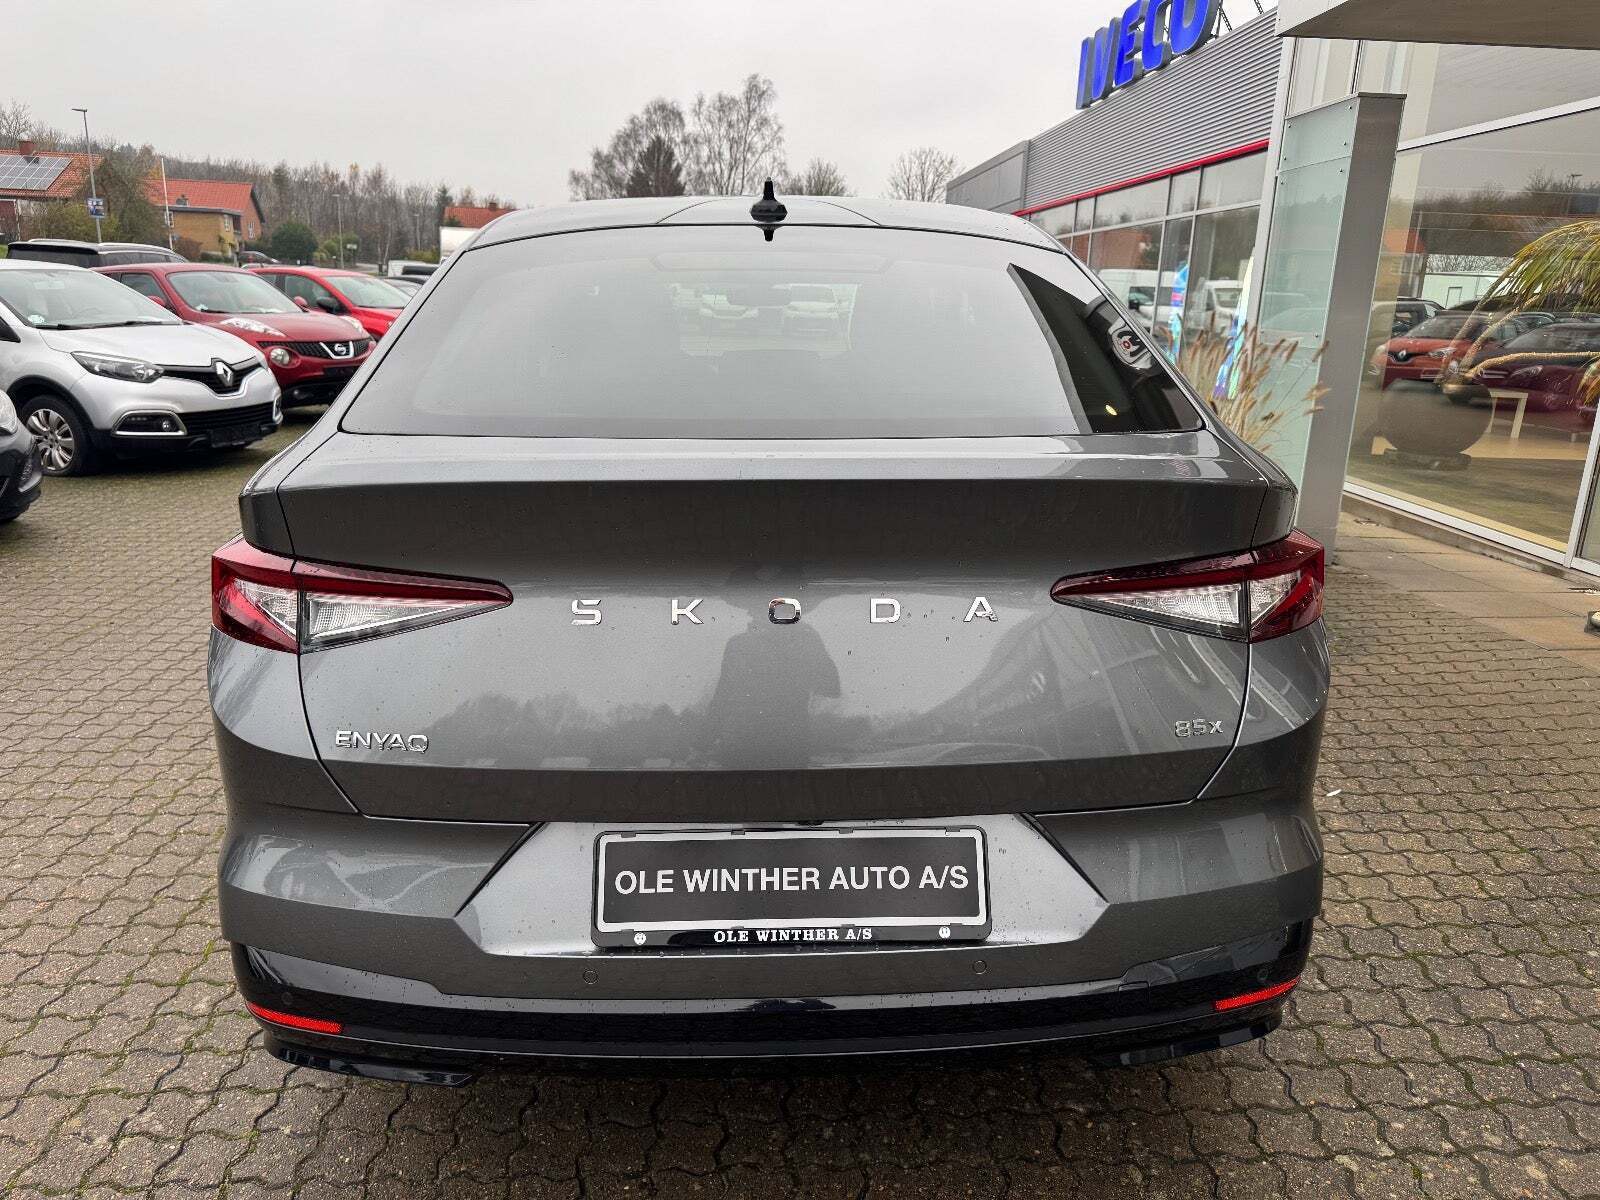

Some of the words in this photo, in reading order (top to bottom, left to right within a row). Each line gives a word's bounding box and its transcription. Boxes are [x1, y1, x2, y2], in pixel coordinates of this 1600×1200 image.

[1076, 0, 1215, 109] IVECO
[571, 596, 999, 625] SKODA
[335, 729, 430, 754] ENYAQ
[614, 870, 675, 895] OLE
[683, 867, 821, 893] WINTHER
[828, 866, 911, 890] AUTO
[918, 865, 970, 889] A/S
[713, 930, 749, 943] OLE
[756, 928, 840, 942] WINTHER
[844, 927, 873, 941] A/S
